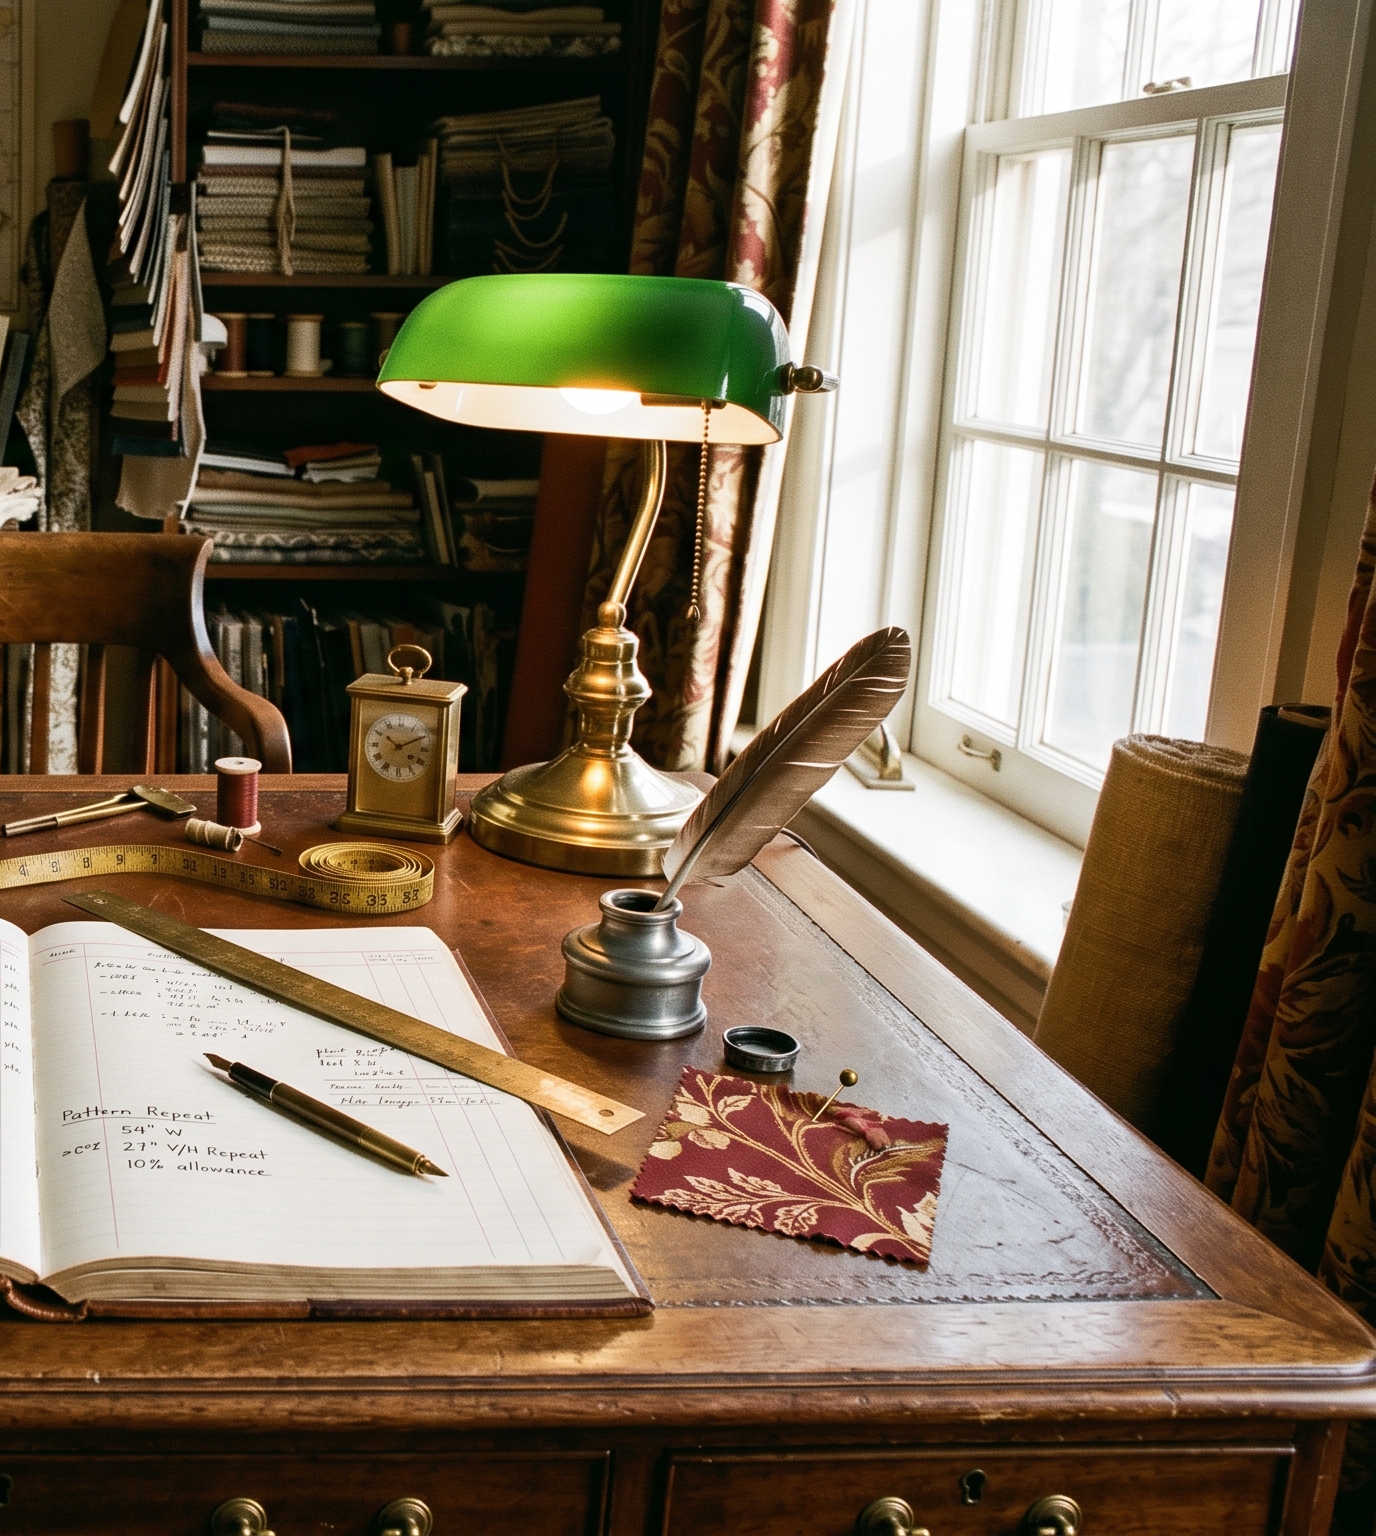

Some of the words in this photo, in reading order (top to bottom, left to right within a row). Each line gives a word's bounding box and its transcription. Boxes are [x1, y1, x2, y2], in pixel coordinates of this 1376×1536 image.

[62, 1105, 132, 1121] Pattern
[147, 1106, 215, 1122] Repeat
[121, 1124, 154, 1135] 54"
[164, 1127, 183, 1137] W
[123, 1141, 157, 1152] 27"
[167, 1143, 198, 1157] V/H
[207, 1146, 269, 1162] Repeat
[127, 1159, 164, 1170] 10%
[177, 1159, 272, 1177] allowance
